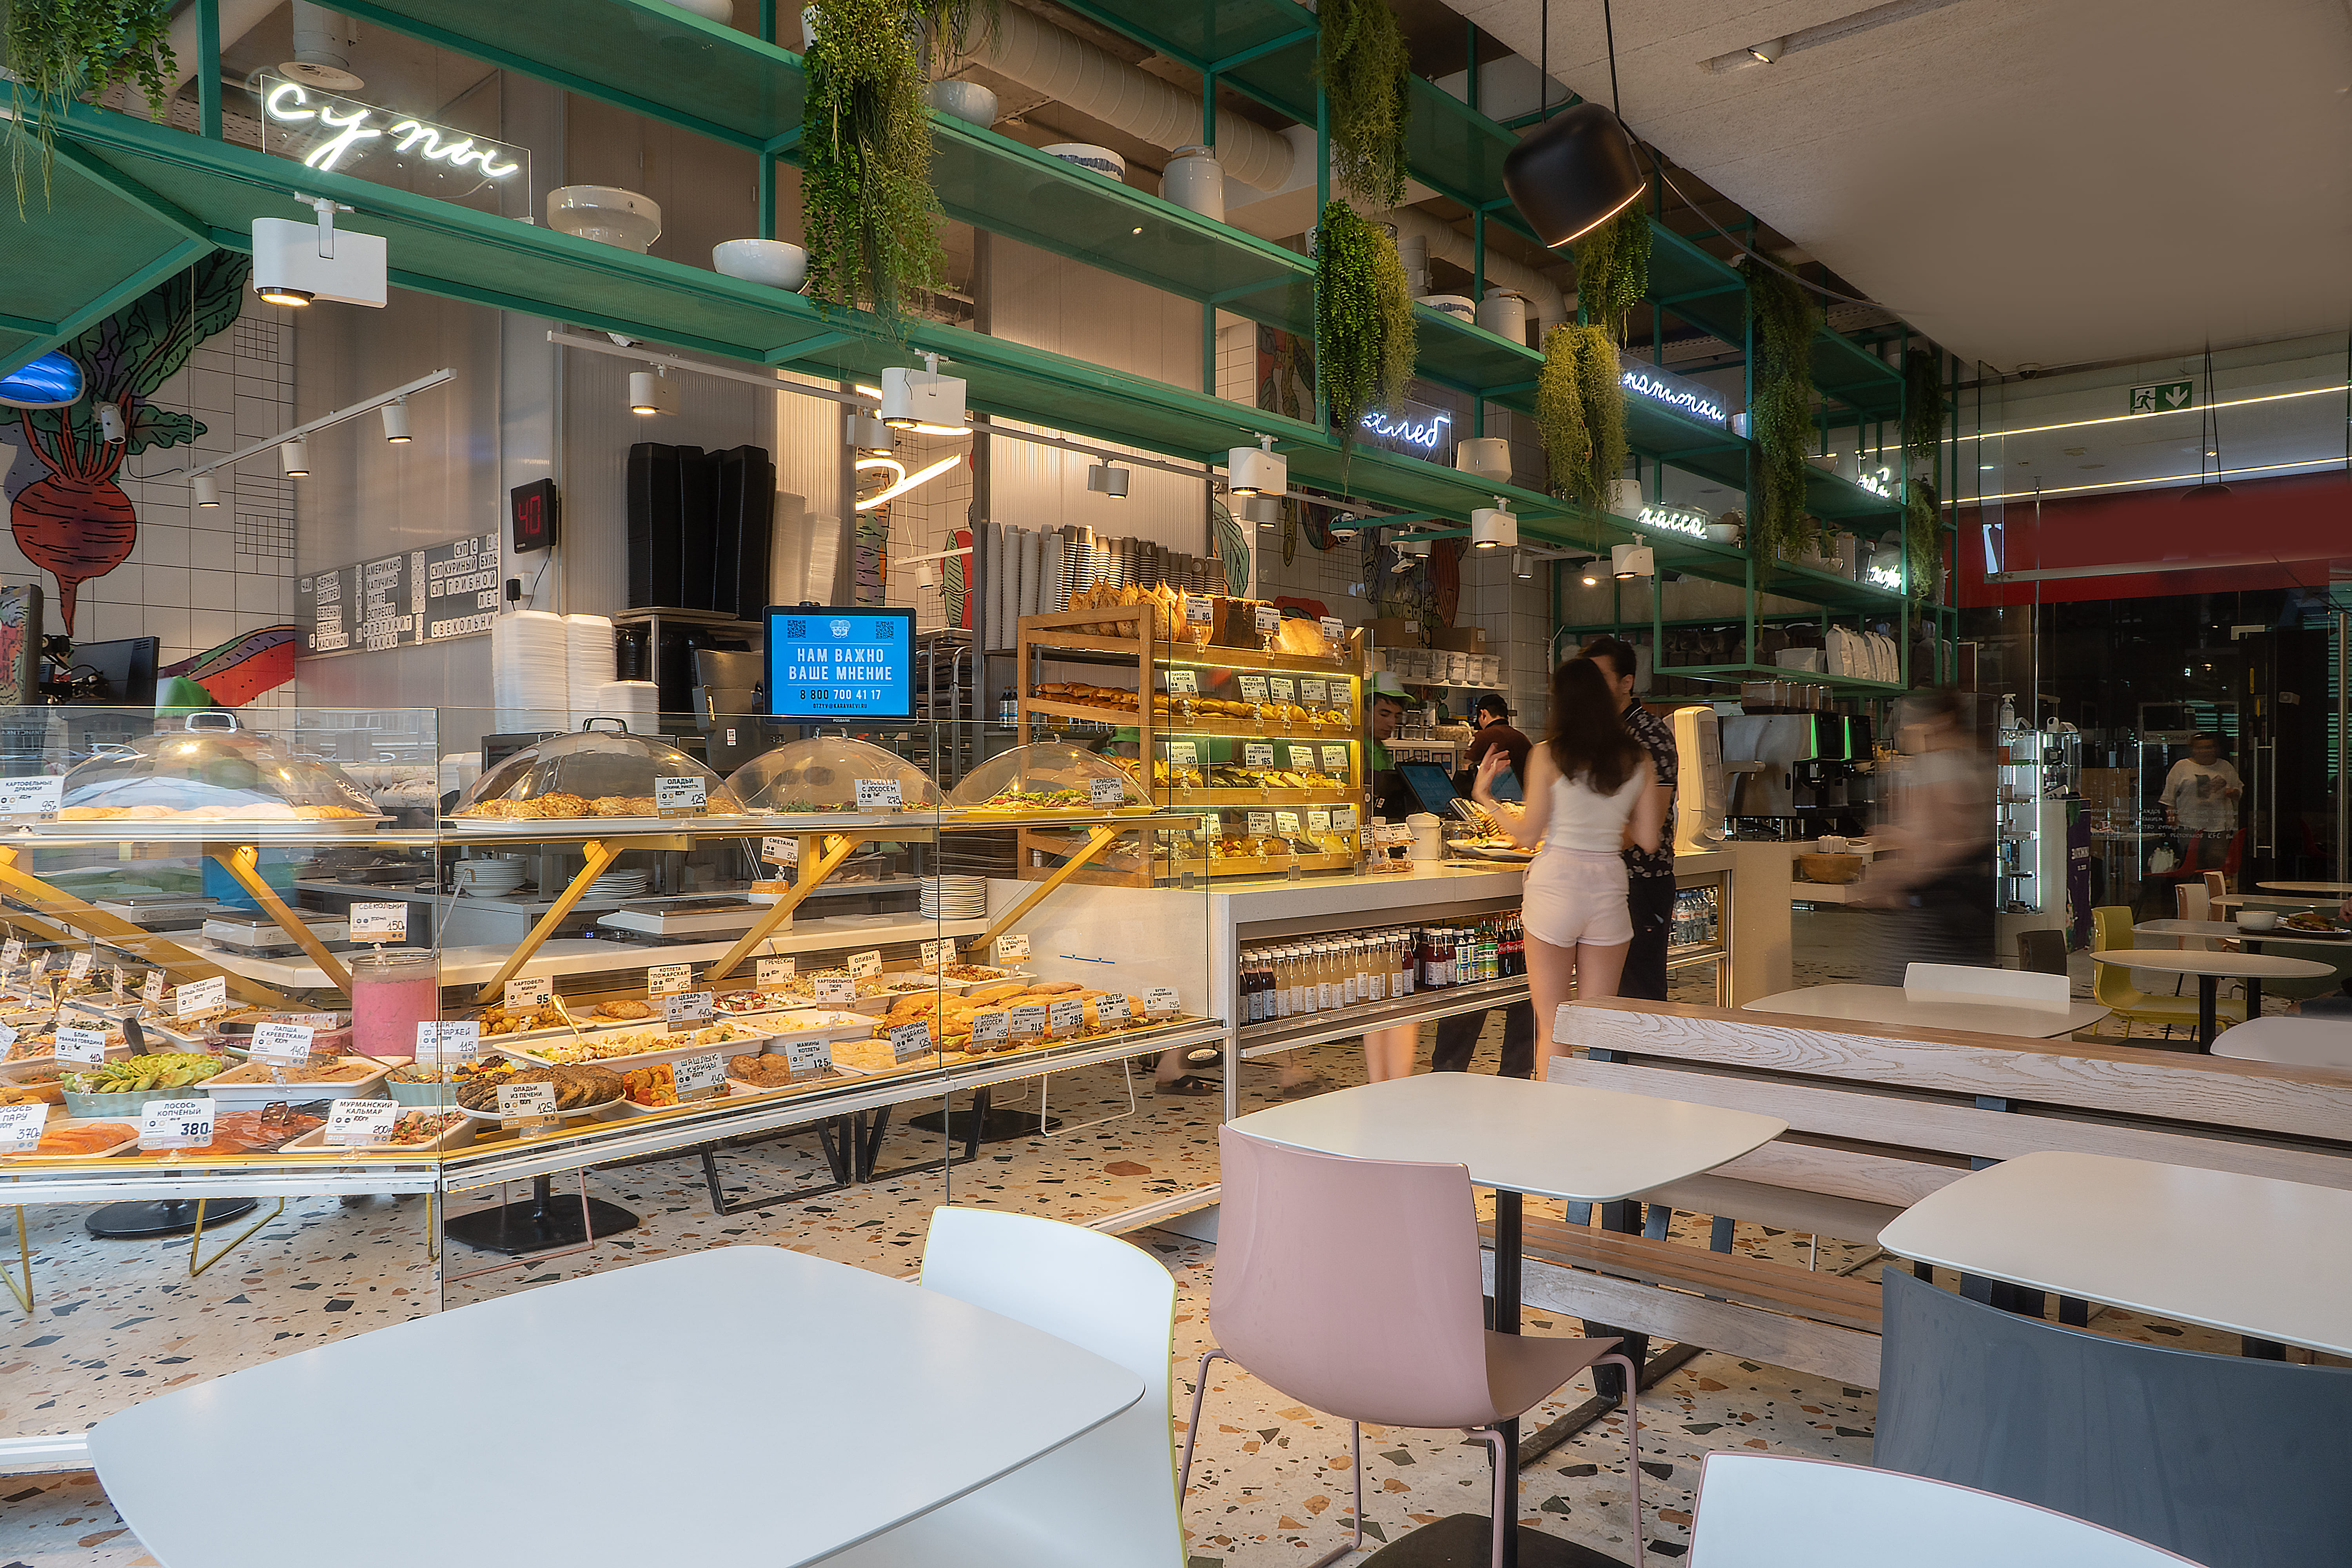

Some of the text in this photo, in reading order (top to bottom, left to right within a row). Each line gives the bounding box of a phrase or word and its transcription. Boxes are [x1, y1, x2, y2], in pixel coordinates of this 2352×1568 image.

[518, 495, 540, 534] 40
[456, 543, 468, 555] СУП
[472, 541, 476, 552] С
[367, 557, 401, 576] АМЕРИКАНО
[431, 564, 443, 577] СУП
[445, 557, 476, 576] КУРИНЫЙ
[302, 579, 312, 591] ЧАЙ
[367, 573, 397, 591] КАПУЧИНО
[432, 572, 495, 595] СУП ГРИБНОЙ
[368, 591, 385, 606] ЛАТТЕ
[368, 604, 395, 621] ЭСПРЕССО
[433, 615, 498, 635] СВЕКОЛЬНИ
[318, 634, 348, 650] ЖАСМИНОМ
[368, 634, 397, 650] КАКАО
[798, 648, 884, 662] НАМ ВАЖНО
[789, 666, 892, 680] ВАШЕ МНЕНИЕ
[800, 690, 880, 699] 8 800 700 41 17
[769, 838, 793, 847] СМЕТАНА
[924, 944, 950, 953] БАКЛЖАН
[855, 955, 875, 963] ОЛИВЬЕ
[891, 1026, 904, 1034] РУЛЕТ
[980, 1019, 1002, 1027] ЛОСОСЕМ
[681, 1054, 718, 1066] ШАШЛЫК
[687, 1062, 717, 1073] КУРИЦЫ
[3, 1113, 27, 1122] ПАРУ
[158, 1108, 201, 1116] КОПЧЁНЫЙ
